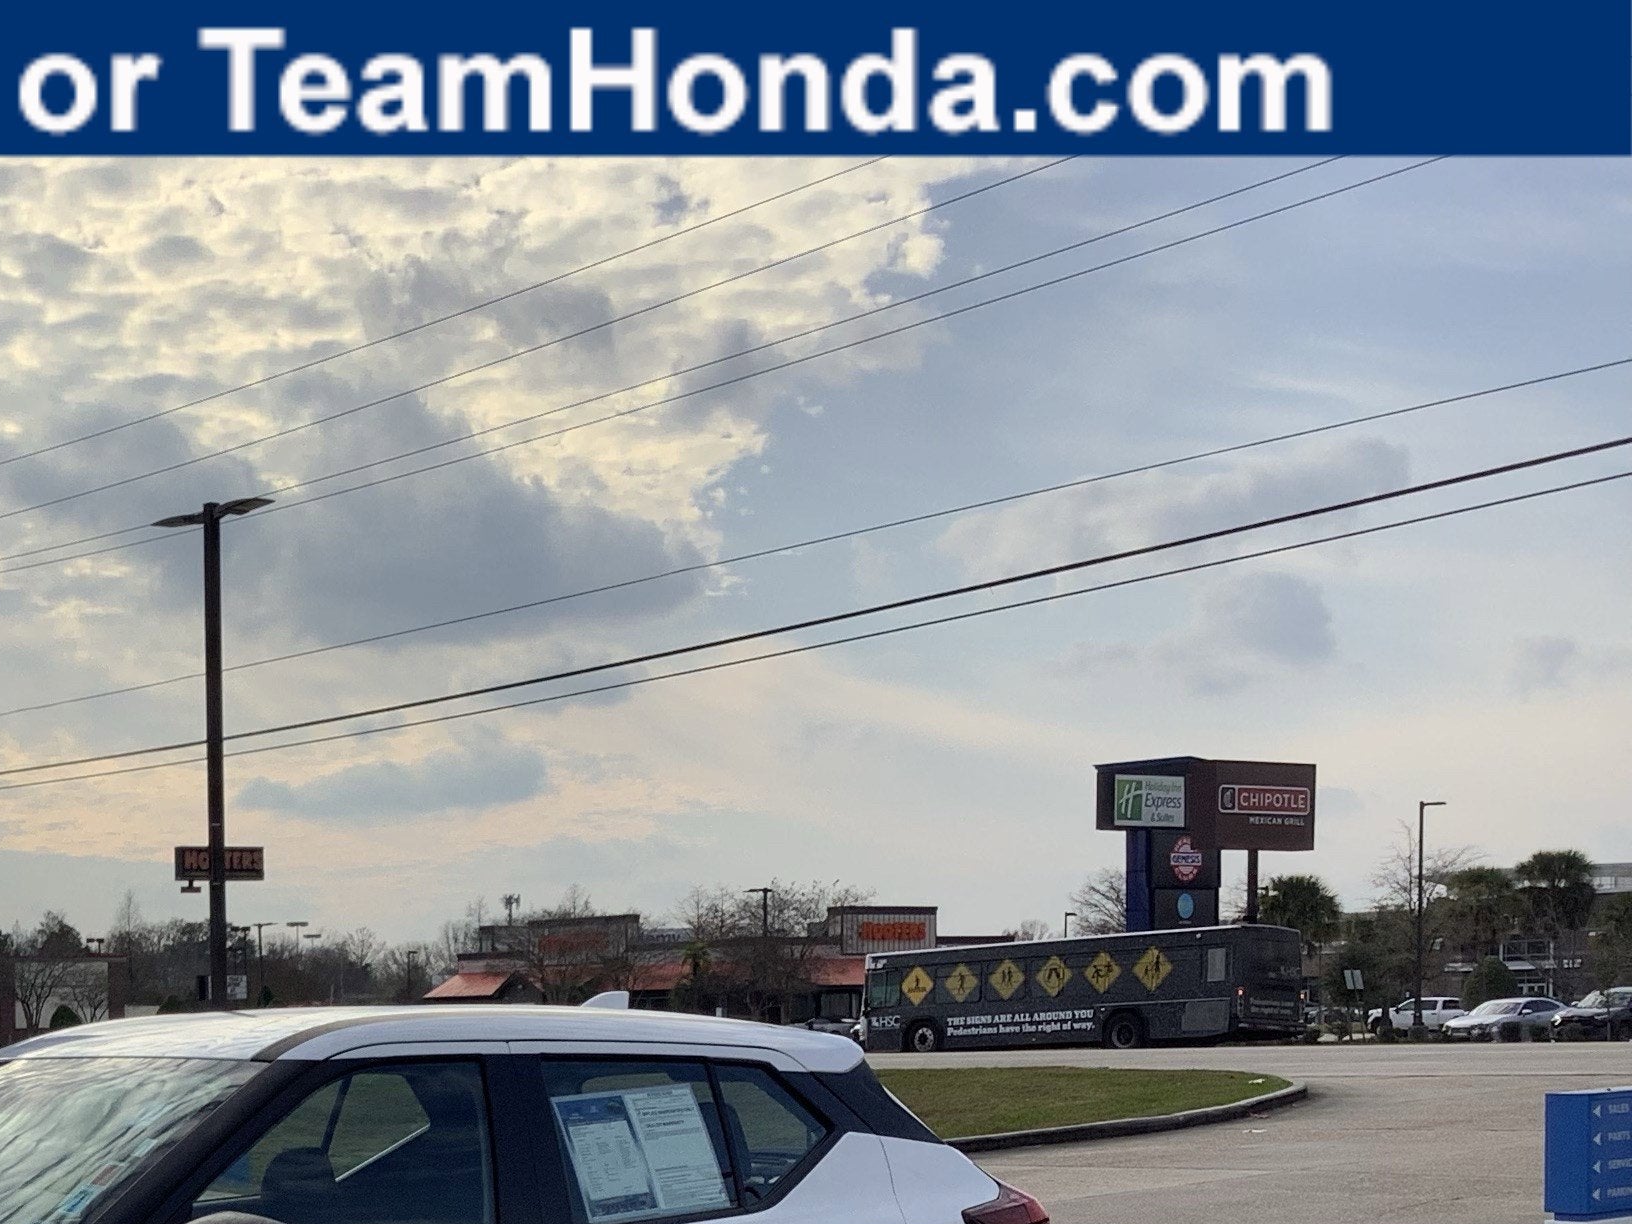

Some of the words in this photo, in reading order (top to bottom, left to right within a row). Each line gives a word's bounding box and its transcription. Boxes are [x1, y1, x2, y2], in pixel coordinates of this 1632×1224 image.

[1145, 793, 1182, 811] Express
[1240, 792, 1306, 808] CHIPOTLE
[1248, 816, 1282, 825] MEXICAN
[1284, 817, 1305, 826] GRILL
[183, 851, 263, 870] HOTERS
[947, 1017, 965, 1026] THE
[966, 1015, 992, 1025] SIGNS
[992, 1014, 1012, 1023] ARE
[1013, 1013, 1031, 1022] ALL
[1032, 1010, 1072, 1021] AROUND
[1073, 1009, 1094, 1019] YOU
[946, 1026, 998, 1036] Pedestrians
[999, 1024, 1020, 1034] have
[1022, 1023, 1037, 1032] the
[1037, 1021, 1061, 1033] right
[1062, 1021, 1071, 1030] of
[1073, 1021, 1095, 1031] way.
[1609, 1103, 1629, 1114] SALES
[1608, 1131, 1631, 1141] PARTS
